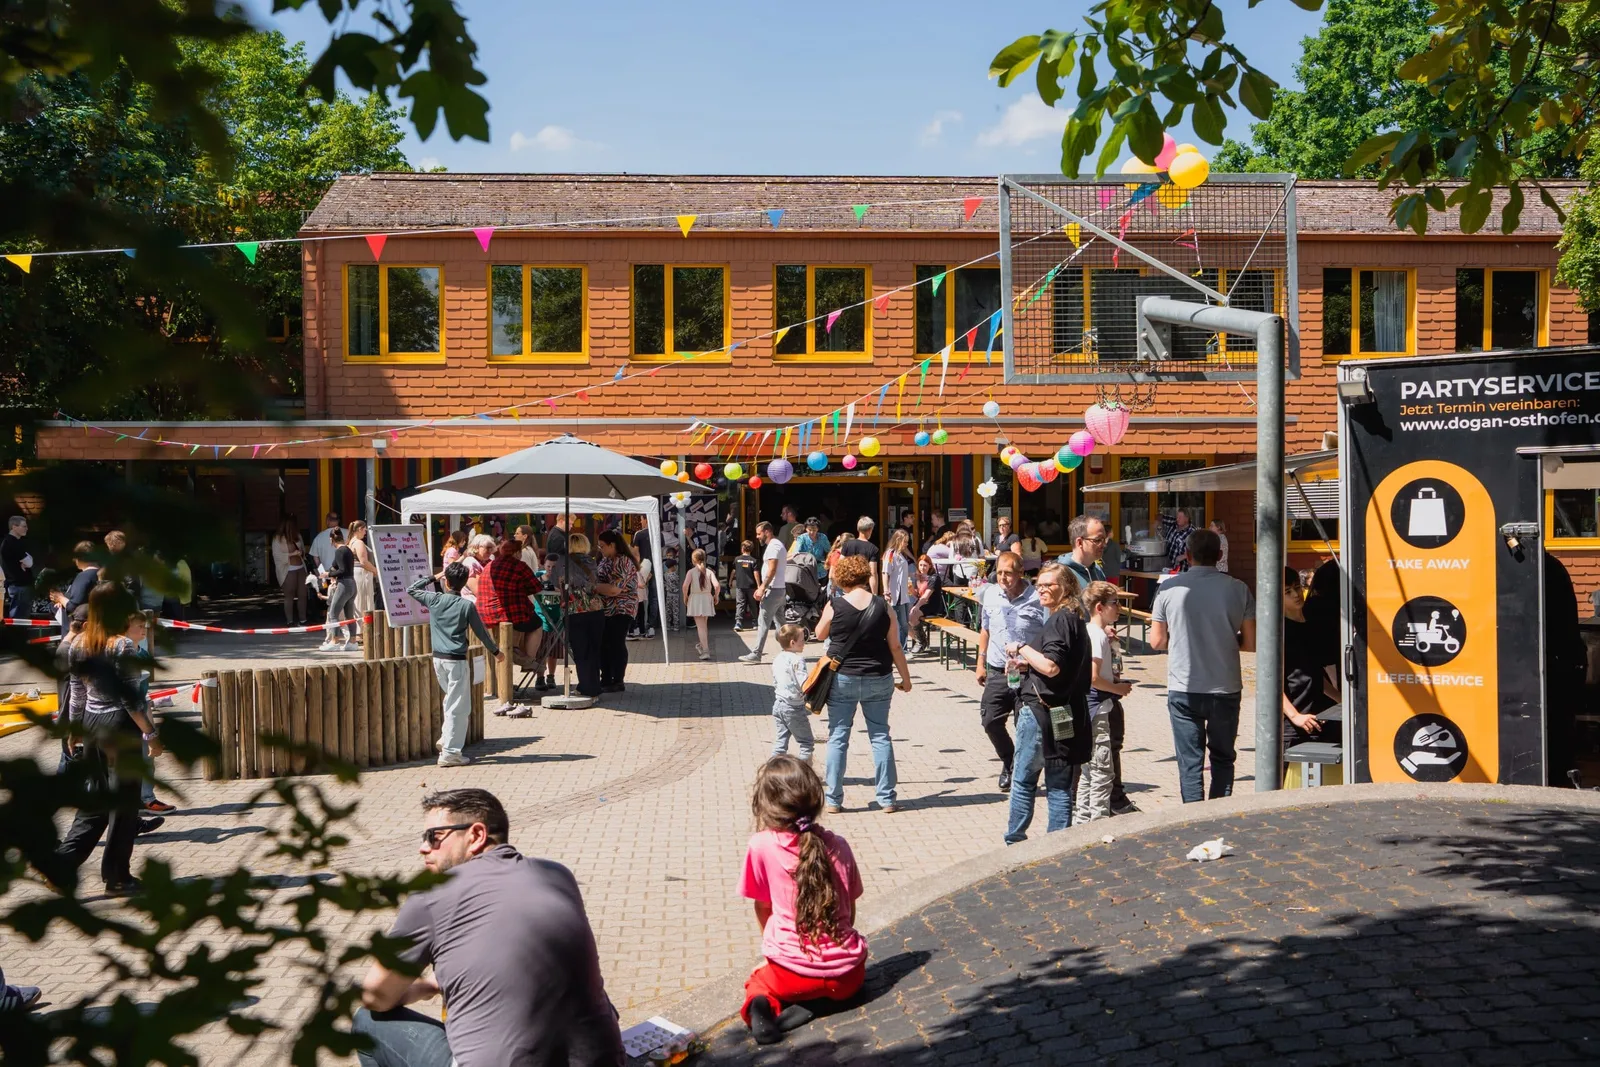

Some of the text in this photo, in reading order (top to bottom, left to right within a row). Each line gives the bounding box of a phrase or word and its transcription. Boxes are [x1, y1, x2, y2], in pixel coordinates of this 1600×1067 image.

[1400, 371, 1600, 400] PARTYSERVICE
[1400, 398, 1580, 416] Jetzt Termin vereinbaren:
[1387, 559, 1470, 570] TAKE AWAY
[1376, 672, 1484, 687] LIEFERSERVICE
